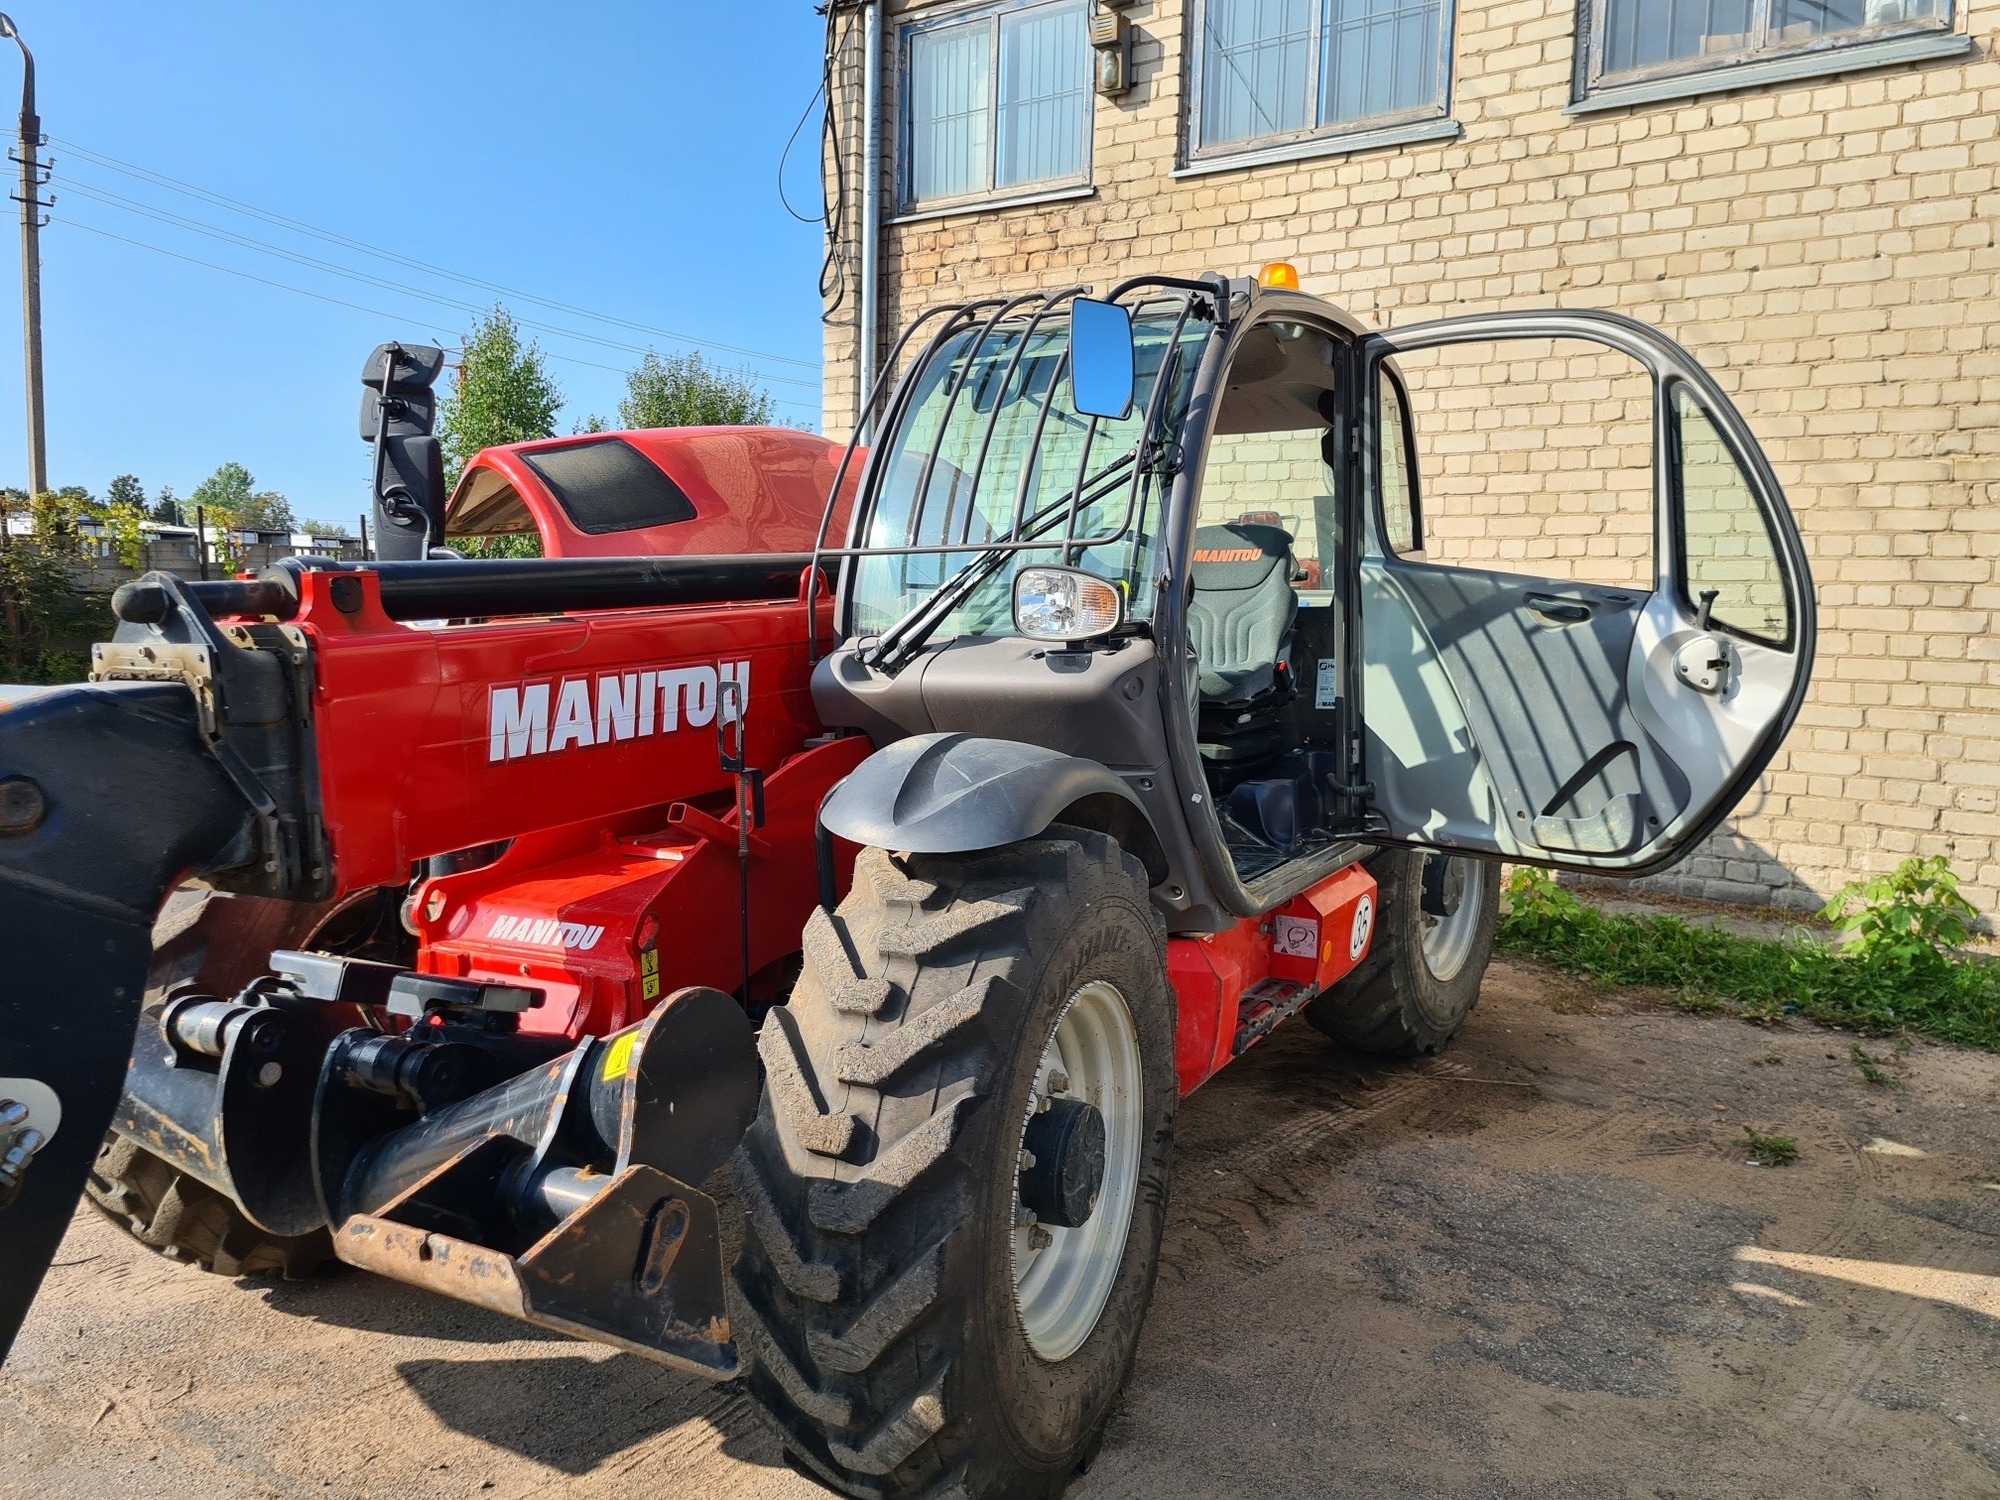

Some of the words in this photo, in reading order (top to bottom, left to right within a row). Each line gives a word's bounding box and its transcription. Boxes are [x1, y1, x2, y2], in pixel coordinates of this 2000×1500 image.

[1192, 548, 1263, 562] MANITOU
[488, 658, 752, 763] MANITOU
[486, 914, 605, 951] MANITOU
[1353, 905, 1369, 950] 35
